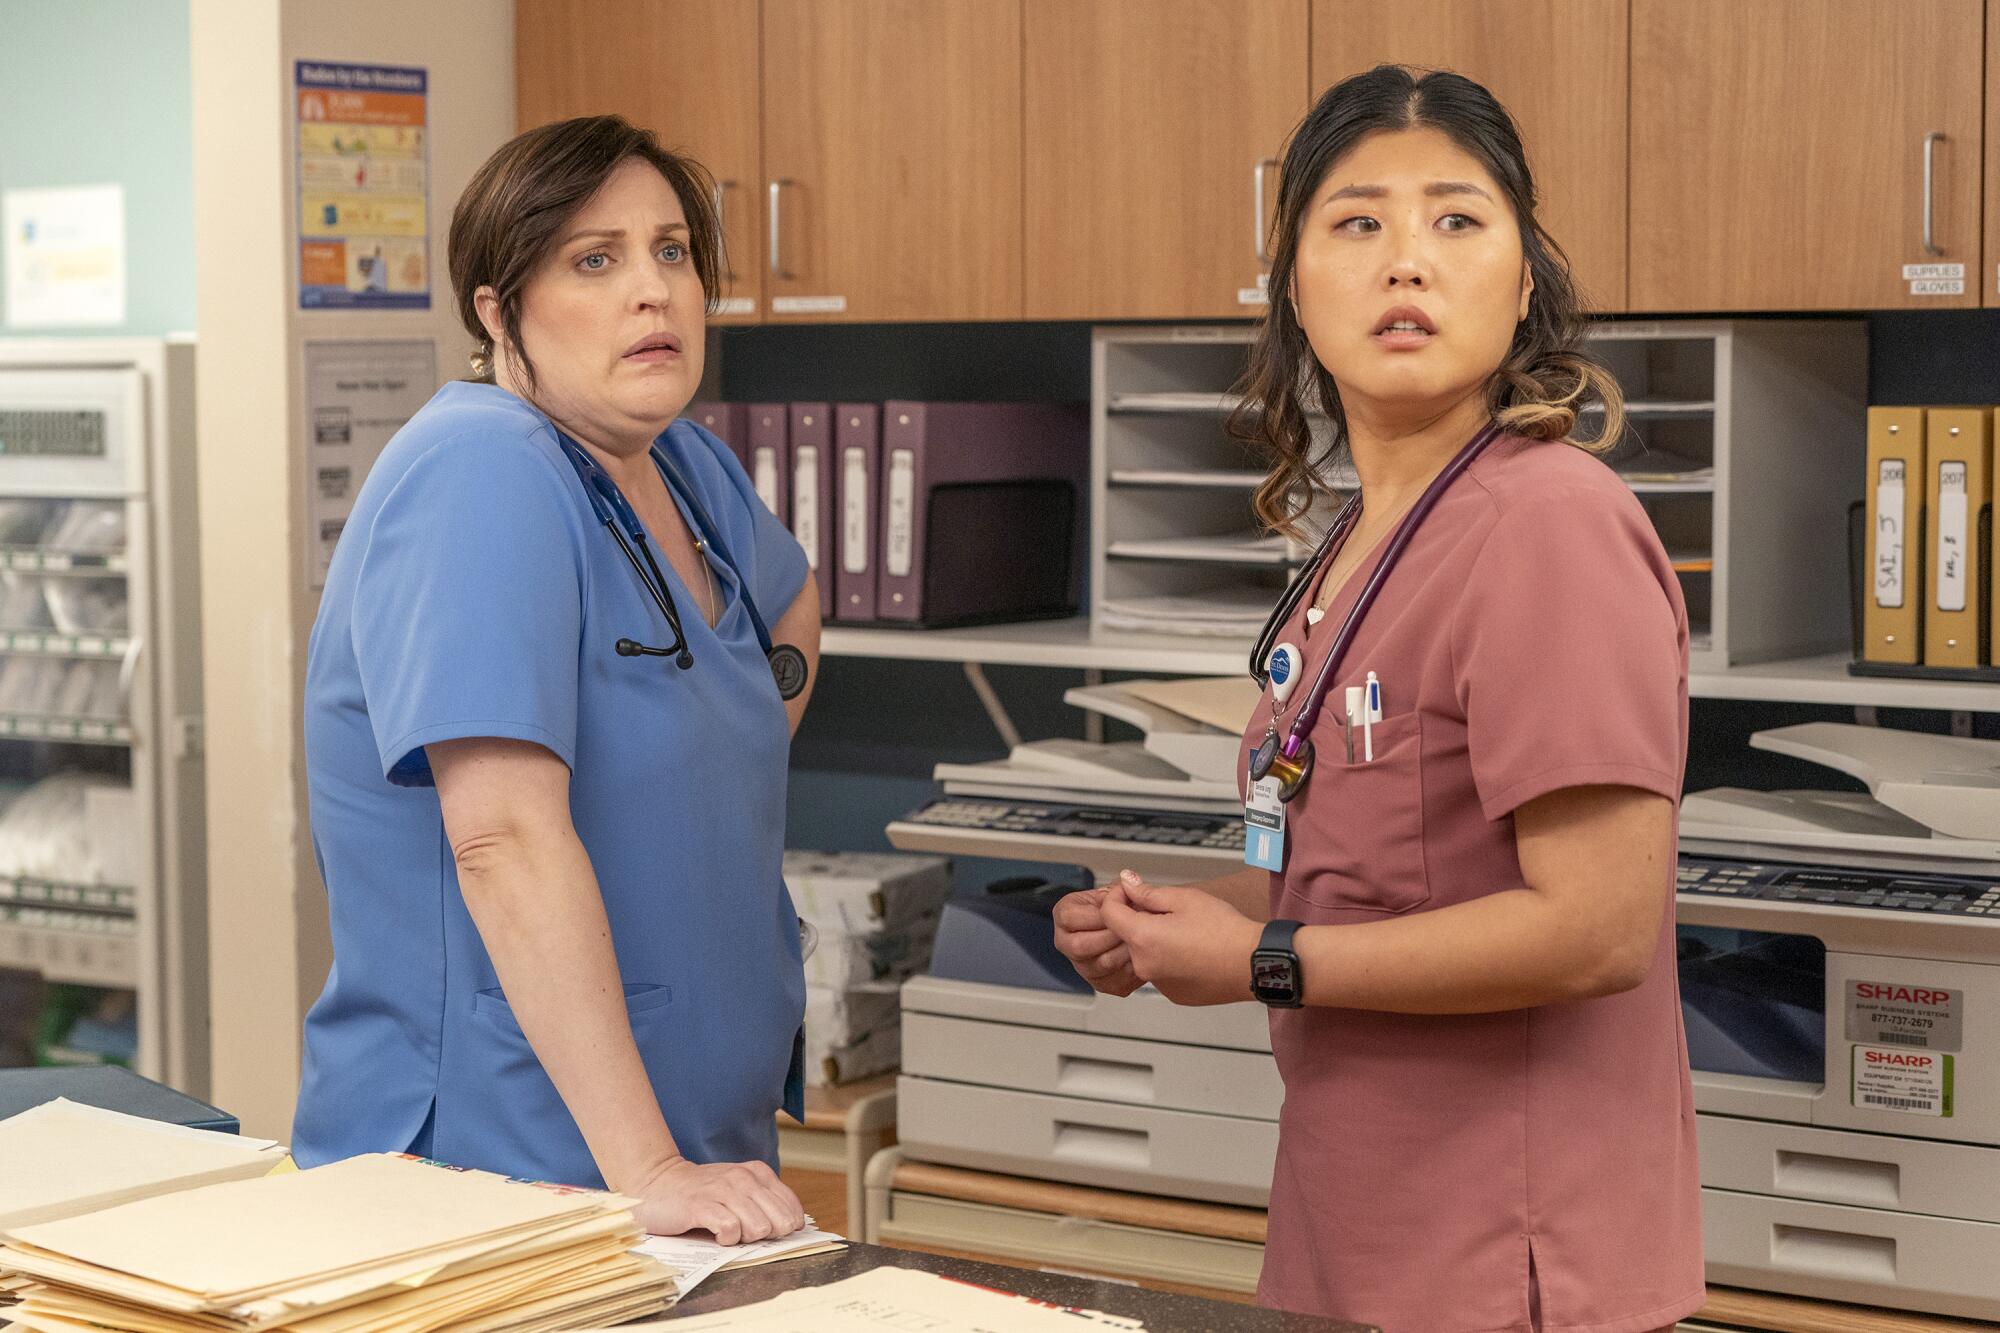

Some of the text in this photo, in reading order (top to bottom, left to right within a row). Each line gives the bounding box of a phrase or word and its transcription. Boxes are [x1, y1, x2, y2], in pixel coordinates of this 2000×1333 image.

[1907, 265, 1960, 277] SUPPLIES
[1915, 282, 1960, 293] GLOVES
[1942, 472, 1964, 485] 207
[1856, 983, 1949, 1006] SHARP
[1881, 1006, 1915, 1016] BUSINESS
[1917, 1010, 1950, 1019] SYSTEMS
[1864, 1051, 1932, 1068] SHARP
